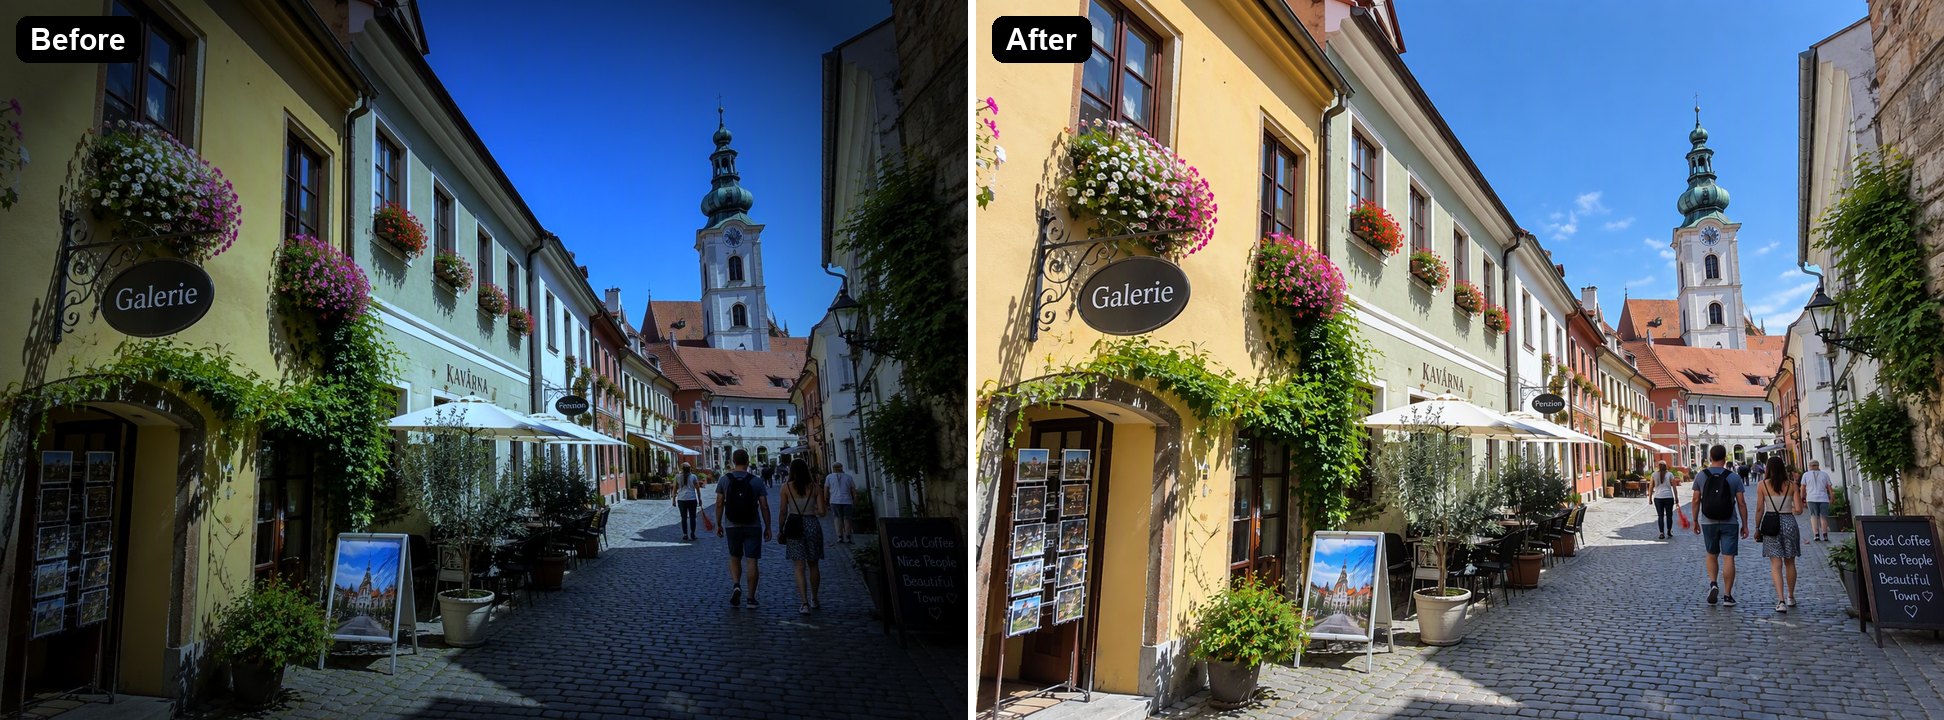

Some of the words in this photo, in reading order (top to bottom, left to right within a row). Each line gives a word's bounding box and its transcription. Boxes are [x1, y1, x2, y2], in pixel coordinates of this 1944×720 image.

[115, 282, 198, 311] Galerie
[1092, 280, 1174, 309] Galerie
[1422, 362, 1465, 393] KAVÁRNA
[1534, 399, 1563, 408] Penzion
[892, 536, 918, 549] Good
[921, 535, 956, 550] Coffee
[1868, 534, 1895, 547] Good
[1897, 534, 1932, 547] Coffee
[897, 555, 921, 568] Nice
[923, 554, 958, 572] People
[1873, 553, 1898, 566] Nice
[1900, 553, 1934, 569] People
[902, 574, 955, 589] Beautiful
[1879, 572, 1931, 587] Beautiful
[913, 590, 945, 604] Town
[1889, 589, 1921, 601] Town
